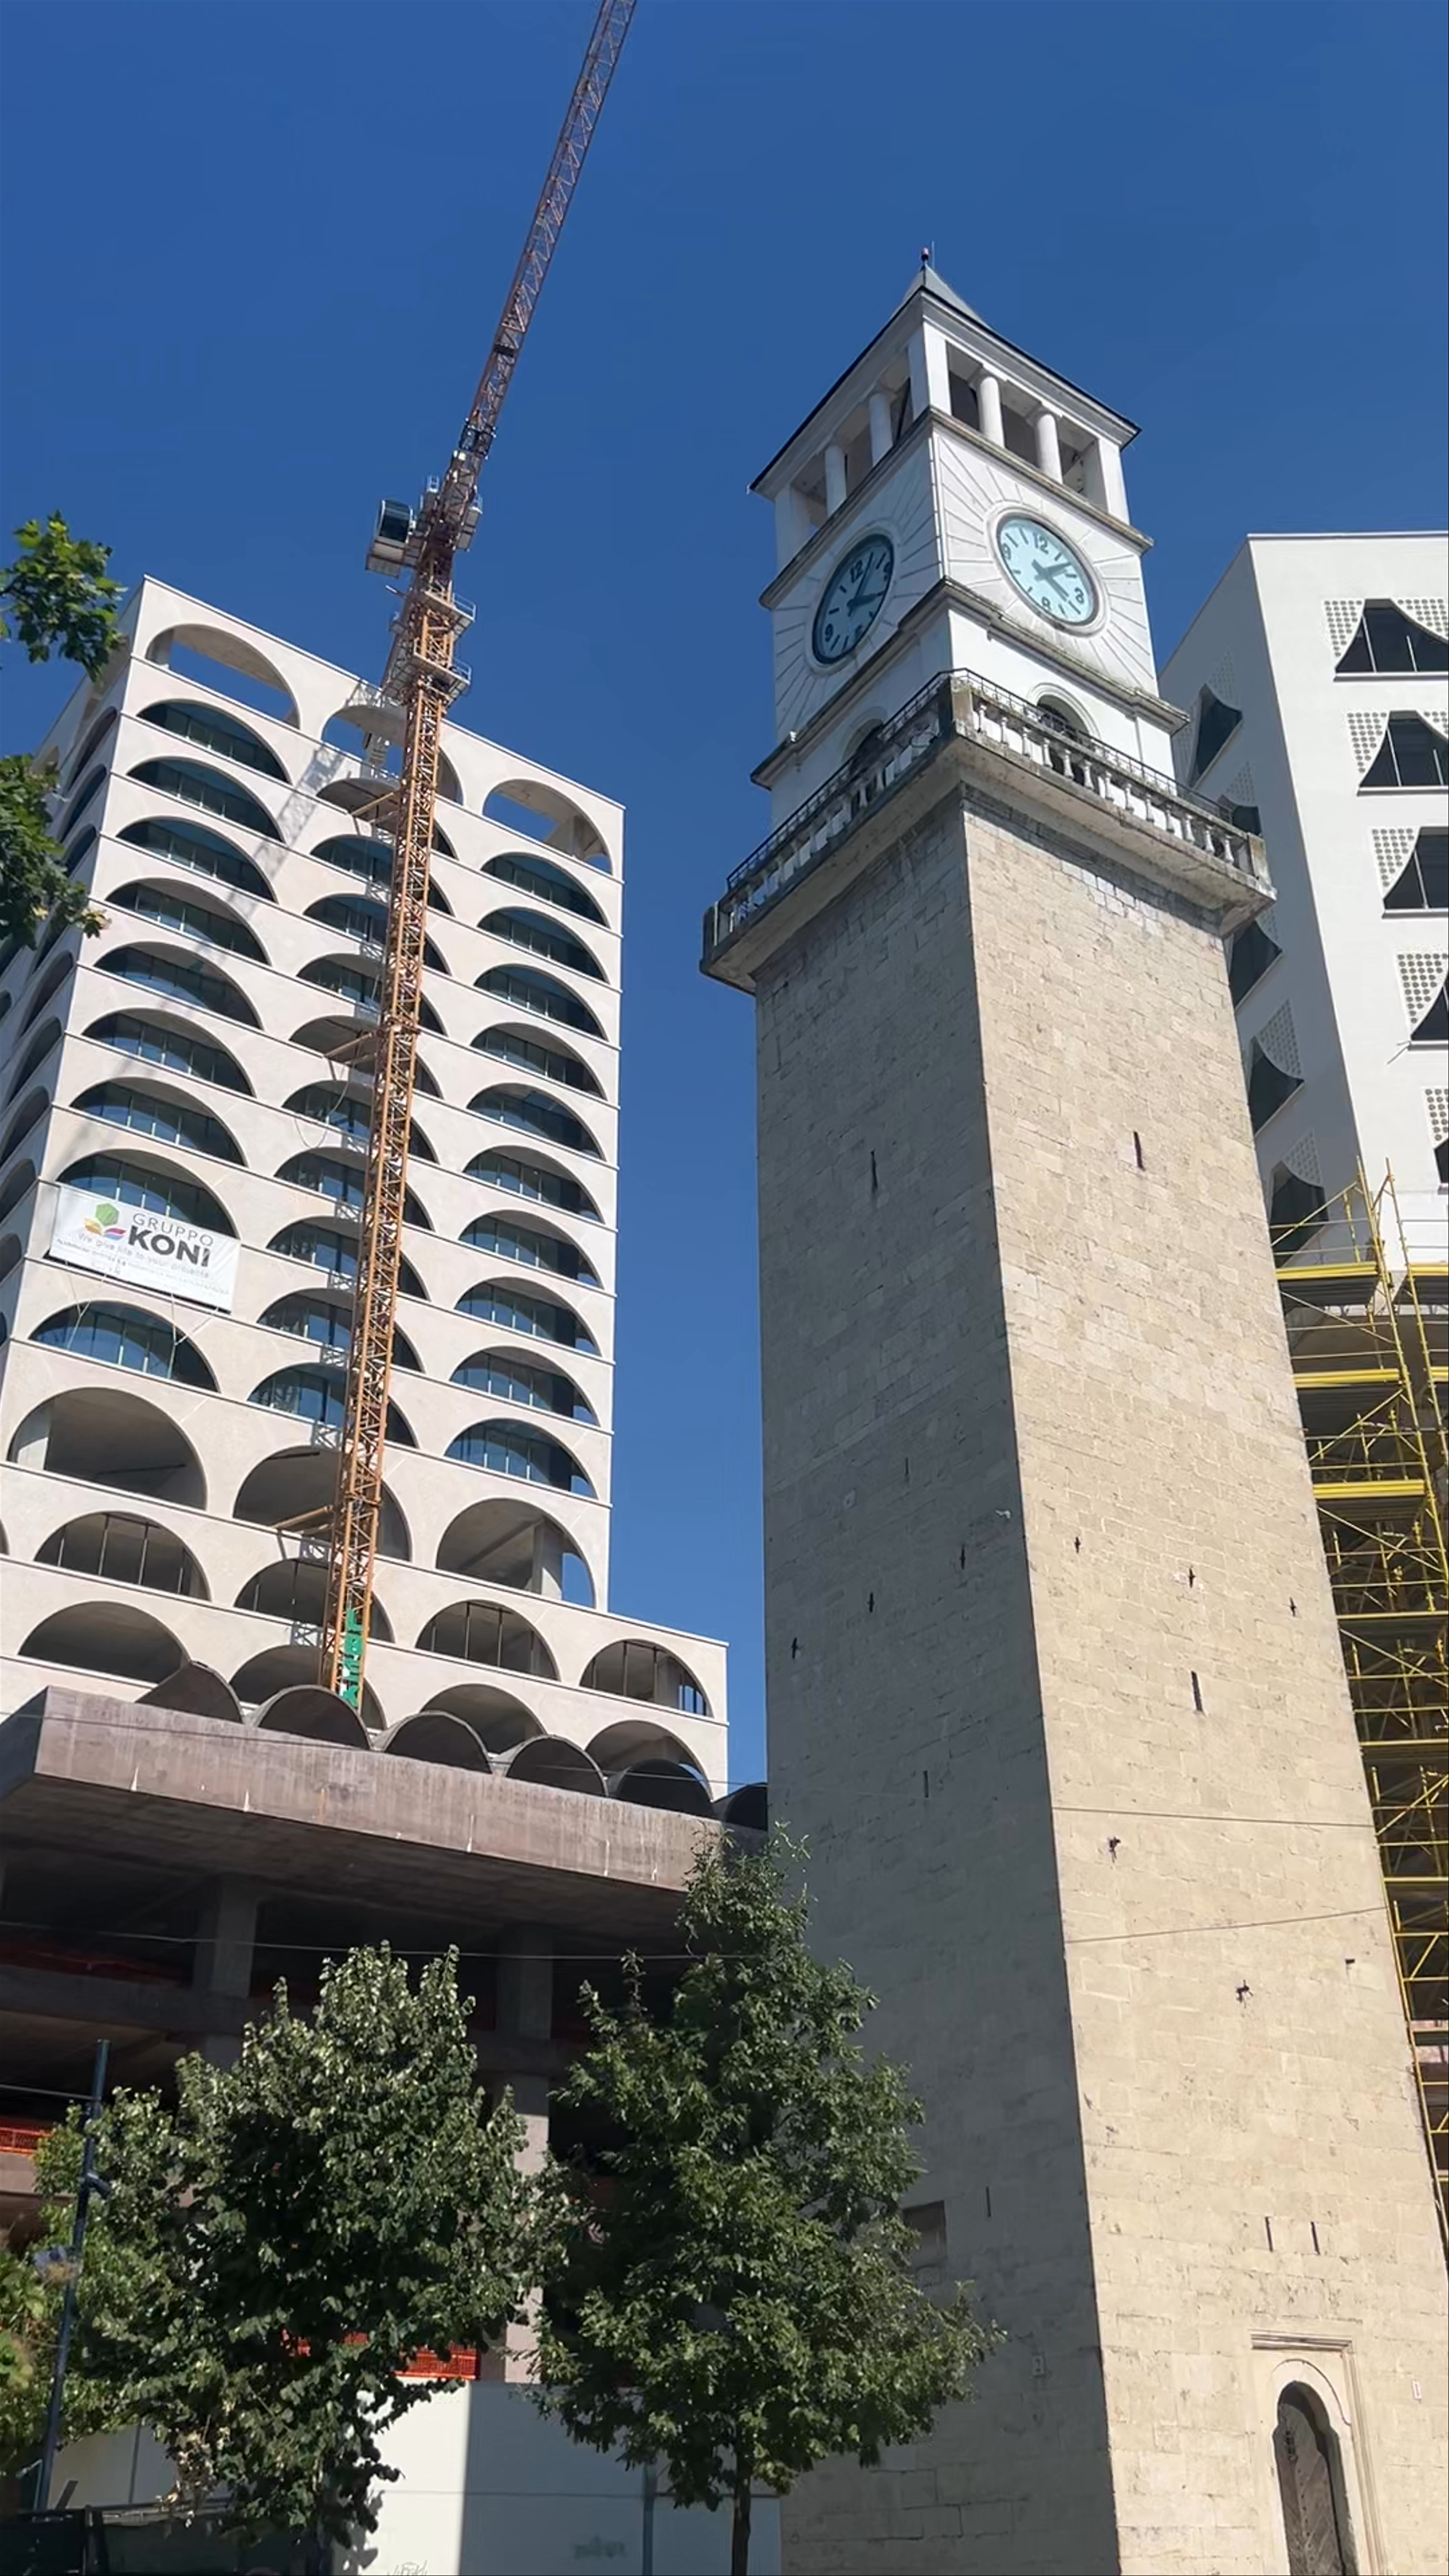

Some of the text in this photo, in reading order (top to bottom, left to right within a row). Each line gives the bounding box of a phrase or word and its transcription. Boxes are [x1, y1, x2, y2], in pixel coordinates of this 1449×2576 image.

[1032, 531, 1049, 555] 12
[850, 560, 863, 583] 12
[825, 623, 834, 642] 9
[133, 1213, 213, 1246] GRUPPO
[128, 1225, 210, 1267] KONI
